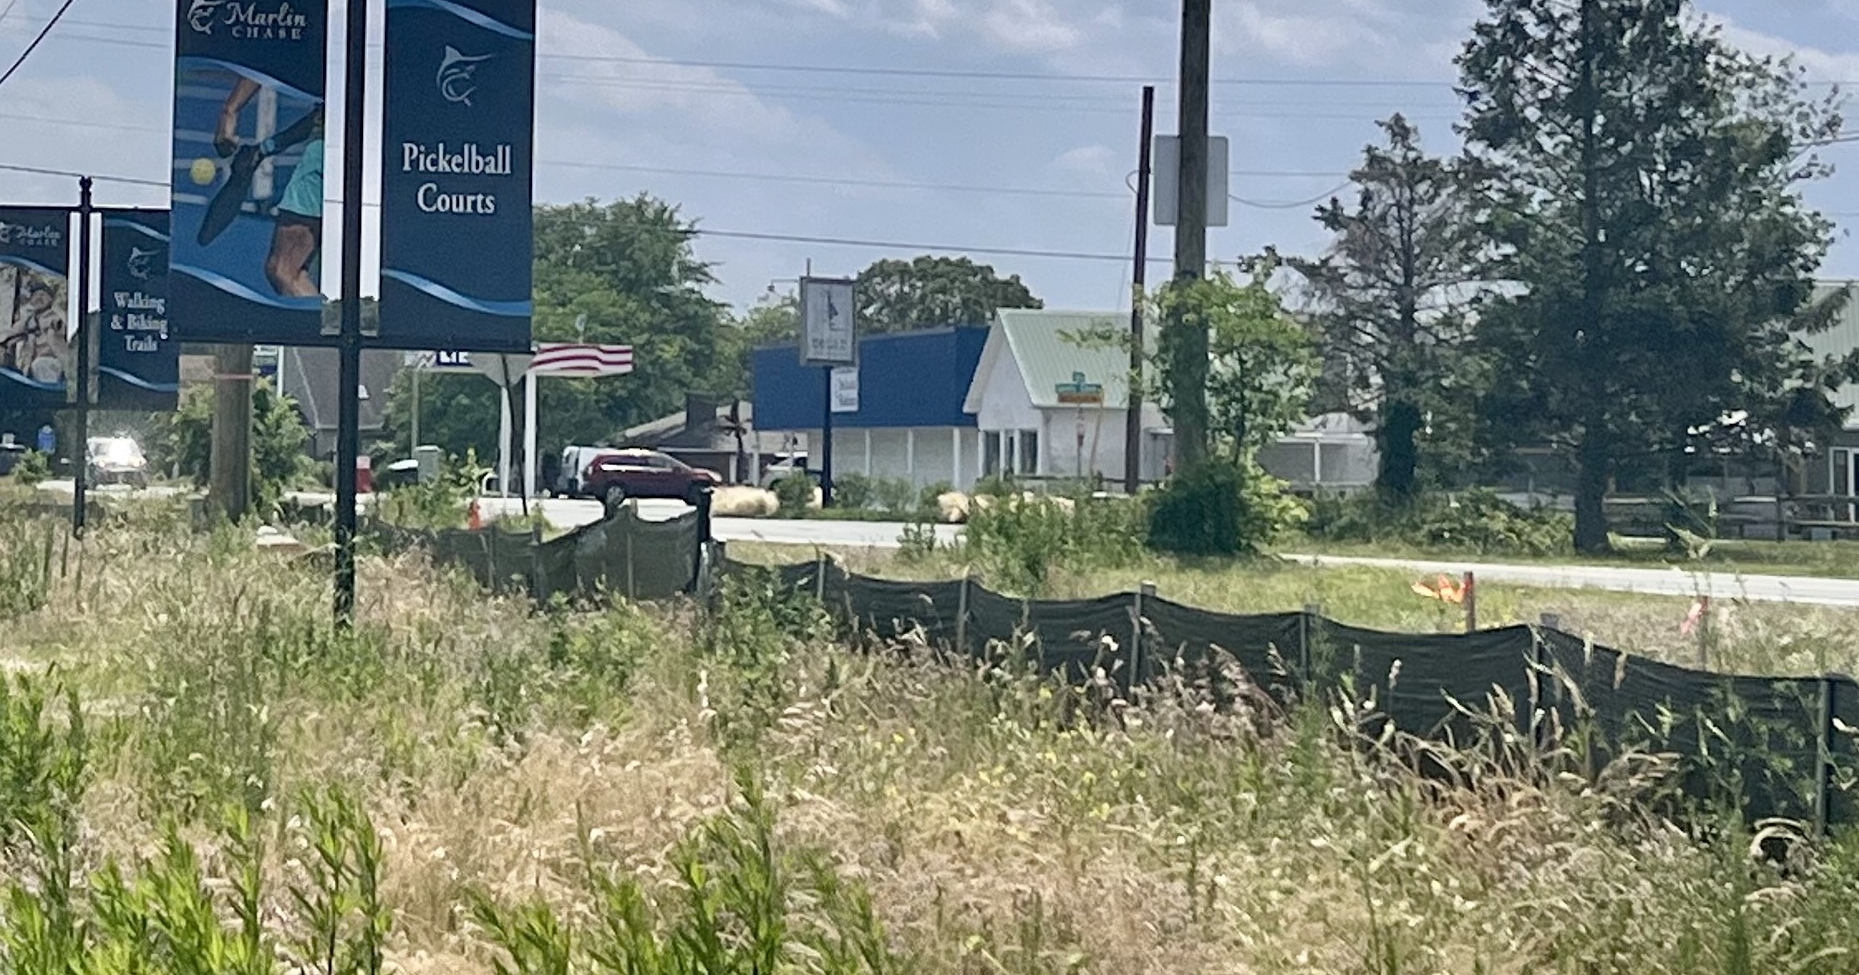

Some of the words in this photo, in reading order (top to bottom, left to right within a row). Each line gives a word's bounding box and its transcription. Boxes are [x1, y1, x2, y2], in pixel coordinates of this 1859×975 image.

[223, 1, 306, 26] Marlin
[232, 26, 302, 40] CHASE
[402, 142, 512, 174] Pickelball
[417, 182, 496, 214] Courts
[114, 291, 165, 315] Walking
[111, 314, 124, 330] &
[127, 313, 168, 336] Biking
[124, 334, 158, 352] Trails
